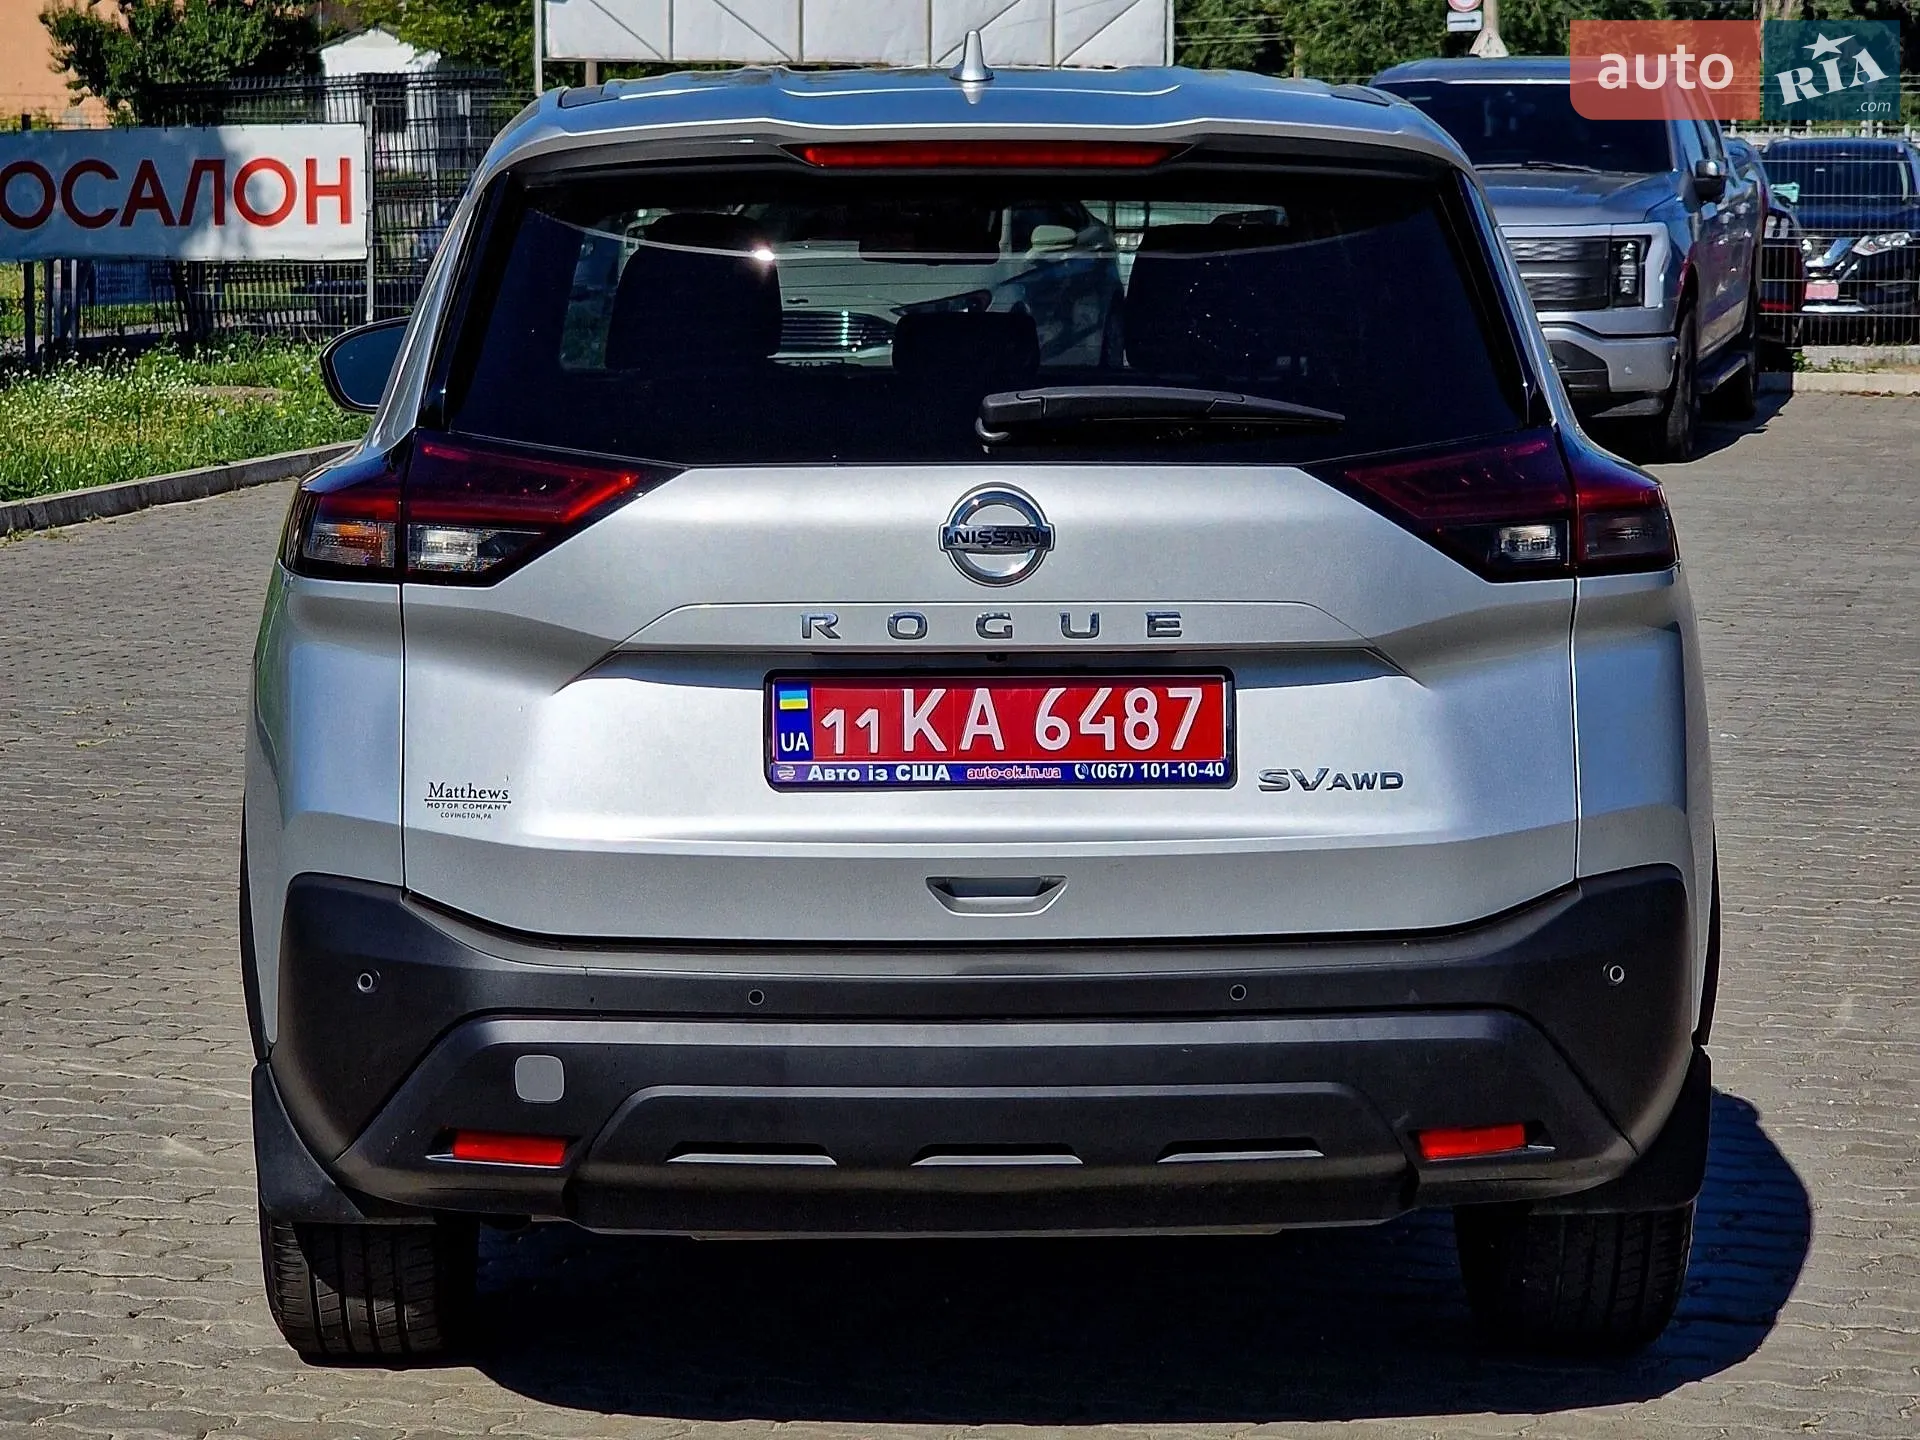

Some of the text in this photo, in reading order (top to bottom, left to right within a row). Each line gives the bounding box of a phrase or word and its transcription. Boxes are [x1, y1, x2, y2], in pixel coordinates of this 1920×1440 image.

[0, 157, 353, 230] ОСАЛОН
[954, 530, 1040, 545] NISSAN
[801, 611, 1183, 640] ROGUE
[1035, 687, 1202, 751] 6487
[780, 732, 810, 752] UA
[895, 764, 951, 781] США
[966, 765, 1062, 780] auto-ok.in.ua
[1090, 762, 1225, 779] (067) 101-10-40
[428, 781, 510, 800] Matthews
[462, 803, 508, 811] COMPANY
